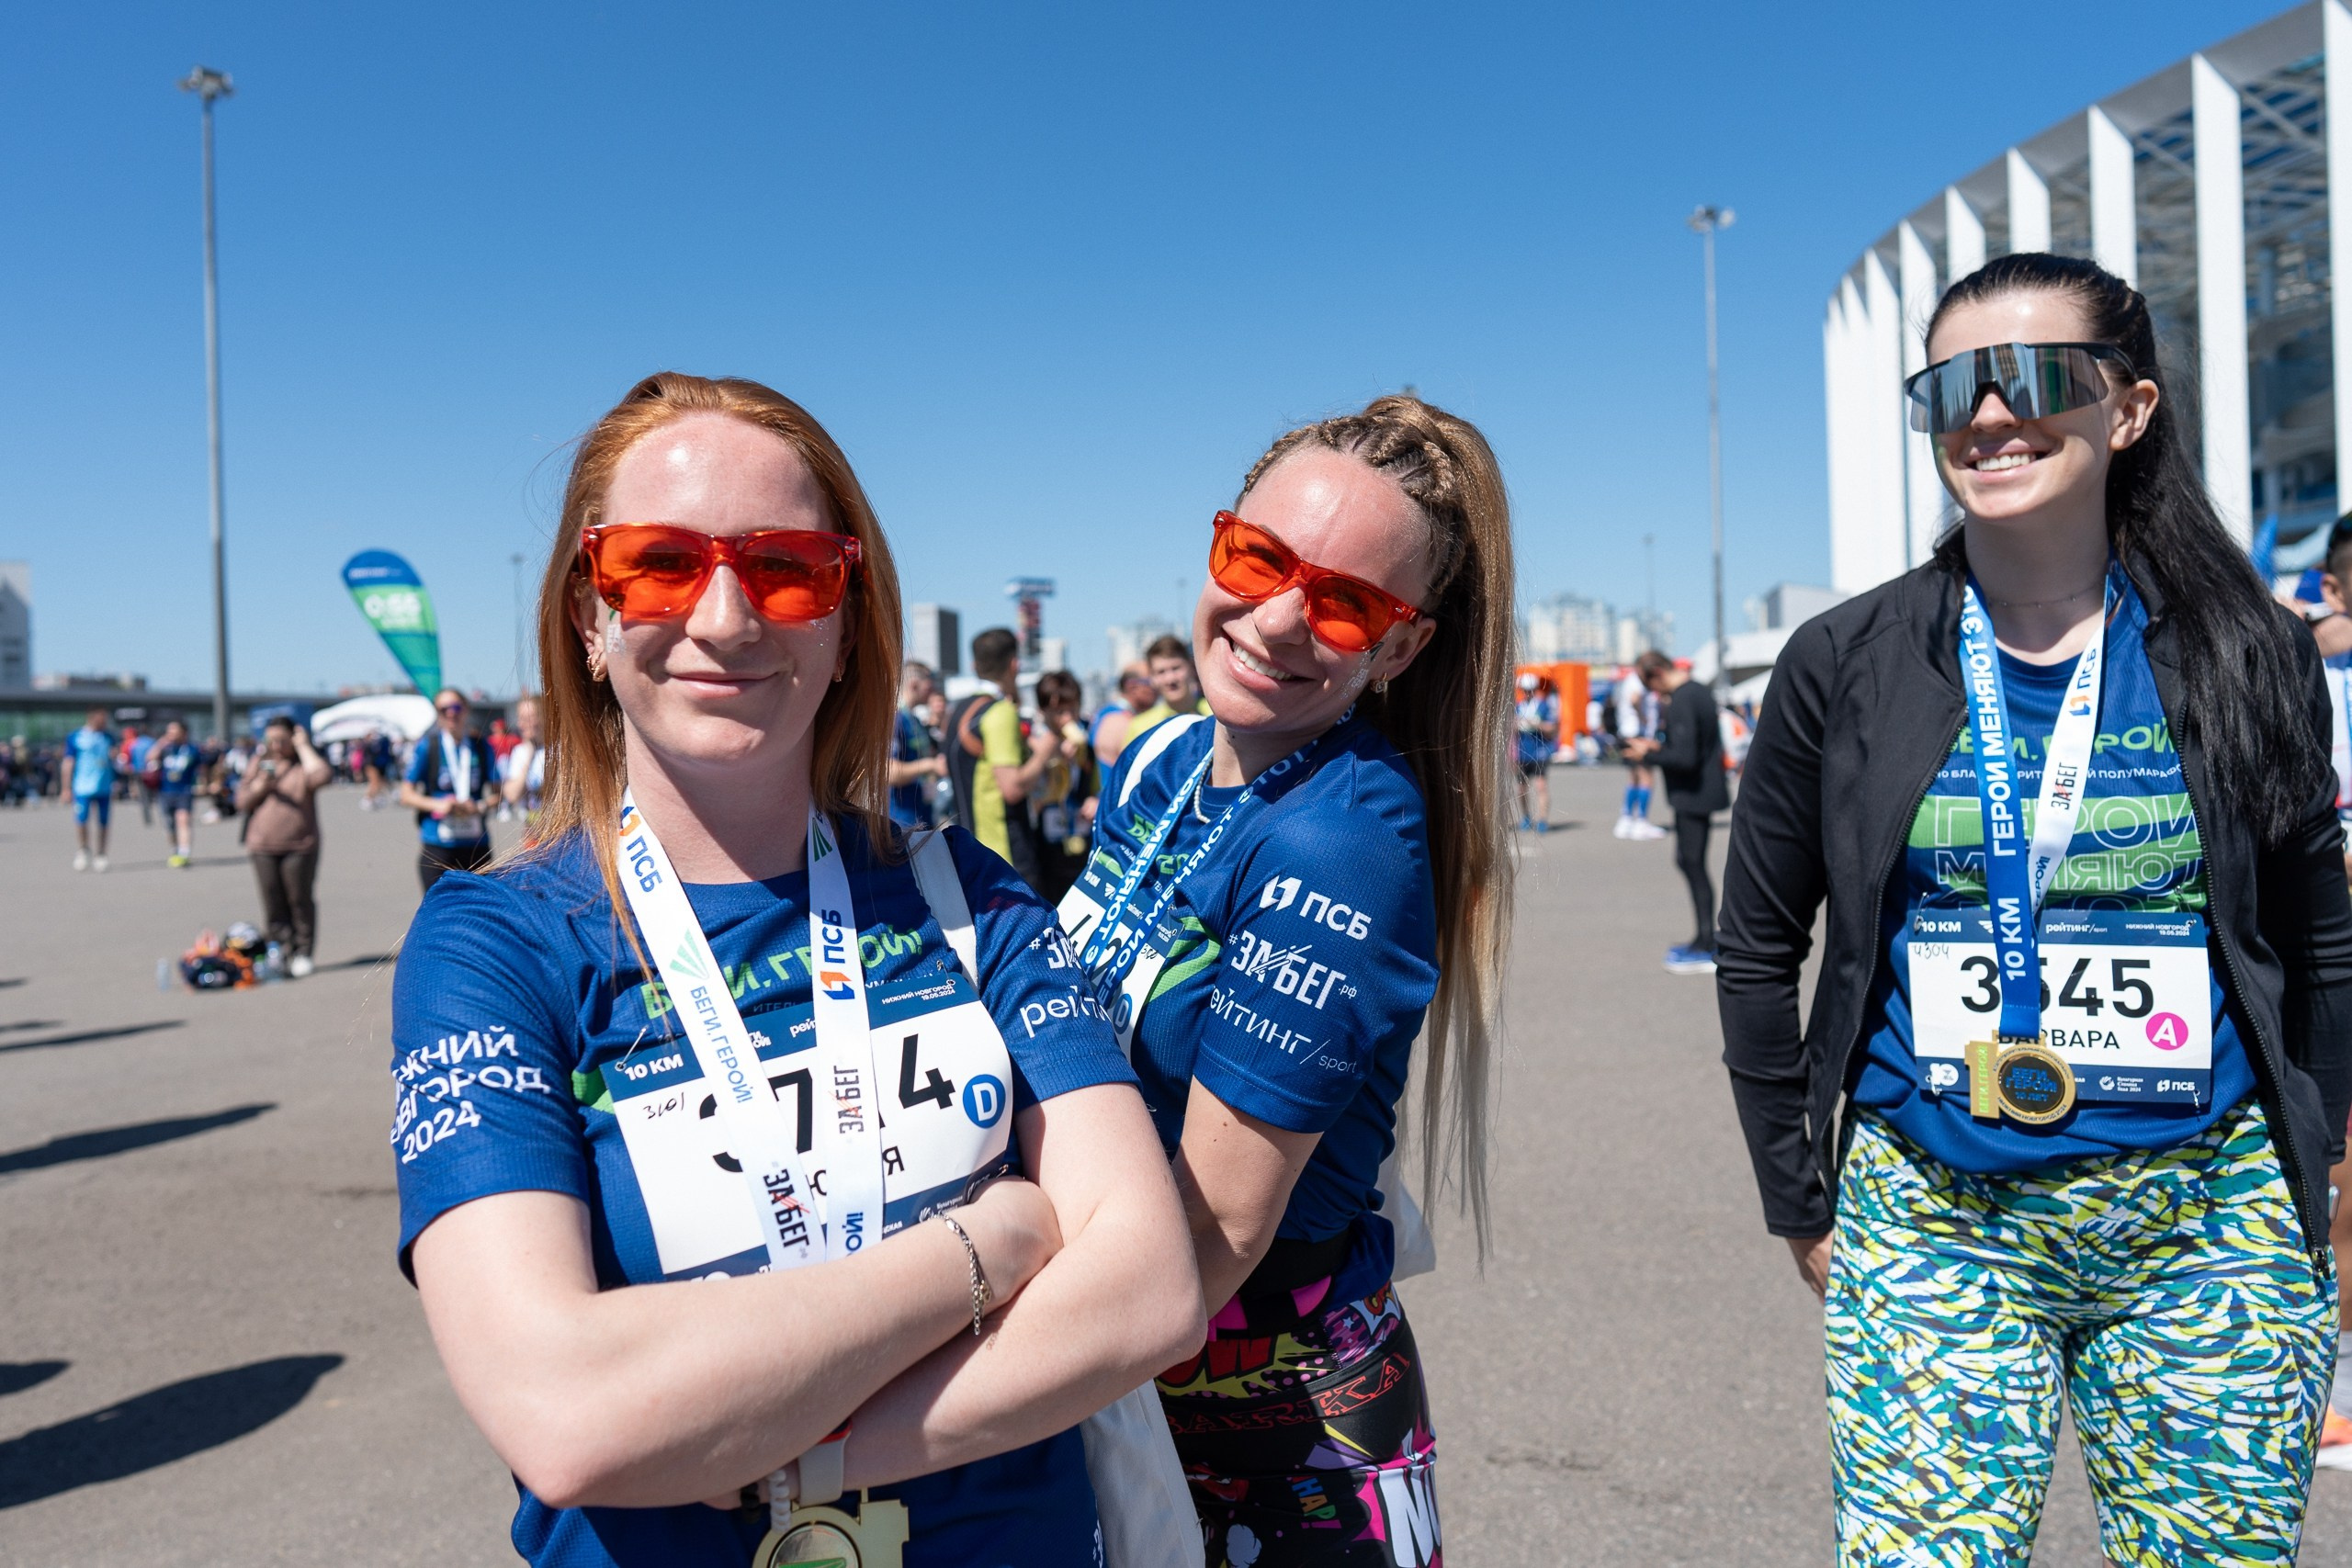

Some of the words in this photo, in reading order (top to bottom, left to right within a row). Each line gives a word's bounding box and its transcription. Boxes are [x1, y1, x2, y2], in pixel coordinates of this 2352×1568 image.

[2077, 648, 2097, 690] ПСБ
[1964, 638, 2007, 757] МЕНЯЮТ
[1984, 761, 2017, 857] ГЕРОИ
[626, 835, 662, 893] ПСБ
[1097, 928, 1146, 1006] ЕРОИ
[1145, 806, 1234, 926] МЕНЯЮТ
[1299, 891, 1372, 941] ПСБ
[1922, 921, 1934, 932] 10
[1939, 921, 1962, 932] КМ
[1997, 897, 2024, 944] КМ
[821, 908, 845, 964] ПСБ
[2004, 949, 2026, 981] 10
[882, 991, 914, 1004] НИЖНИЙ
[2154, 1018, 2177, 1046] A
[625, 1063, 649, 1080] 10
[650, 1054, 684, 1075] КМ
[2172, 1081, 2195, 1091] ПСБ
[390, 1066, 551, 1145] ОВГОРОД
[972, 1082, 998, 1122] D
[401, 1100, 481, 1164] 2024
